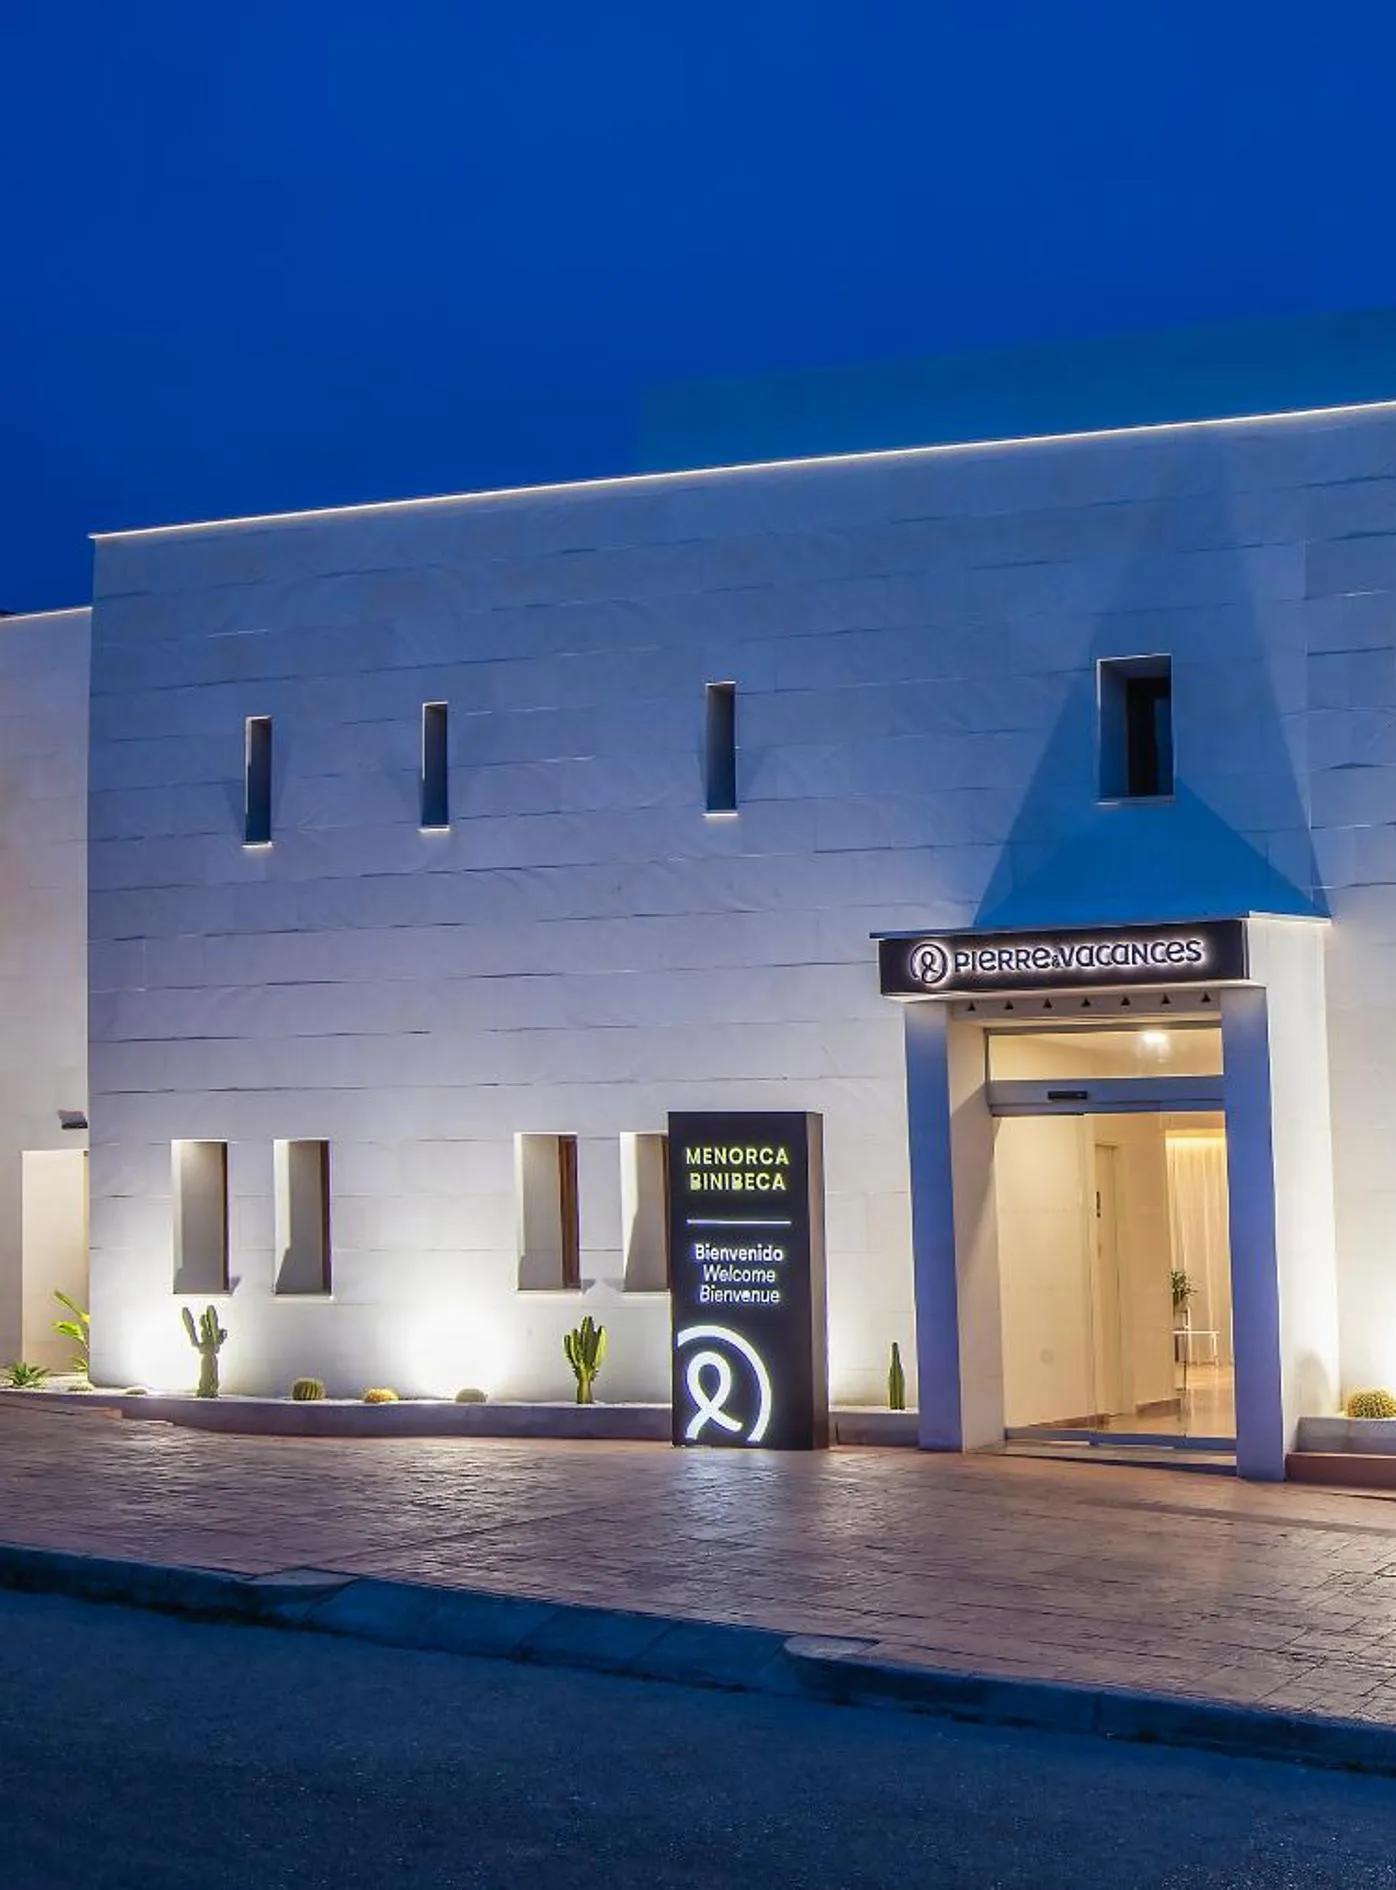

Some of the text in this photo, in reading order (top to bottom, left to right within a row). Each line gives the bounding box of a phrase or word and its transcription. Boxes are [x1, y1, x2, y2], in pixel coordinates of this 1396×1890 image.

[685, 1147, 789, 1166] MENORCA
[689, 1172, 787, 1191] BINIBECA
[694, 1243, 783, 1262] Bienvenido
[702, 1264, 776, 1283] Welcome
[699, 1284, 781, 1303] Bienvenue
